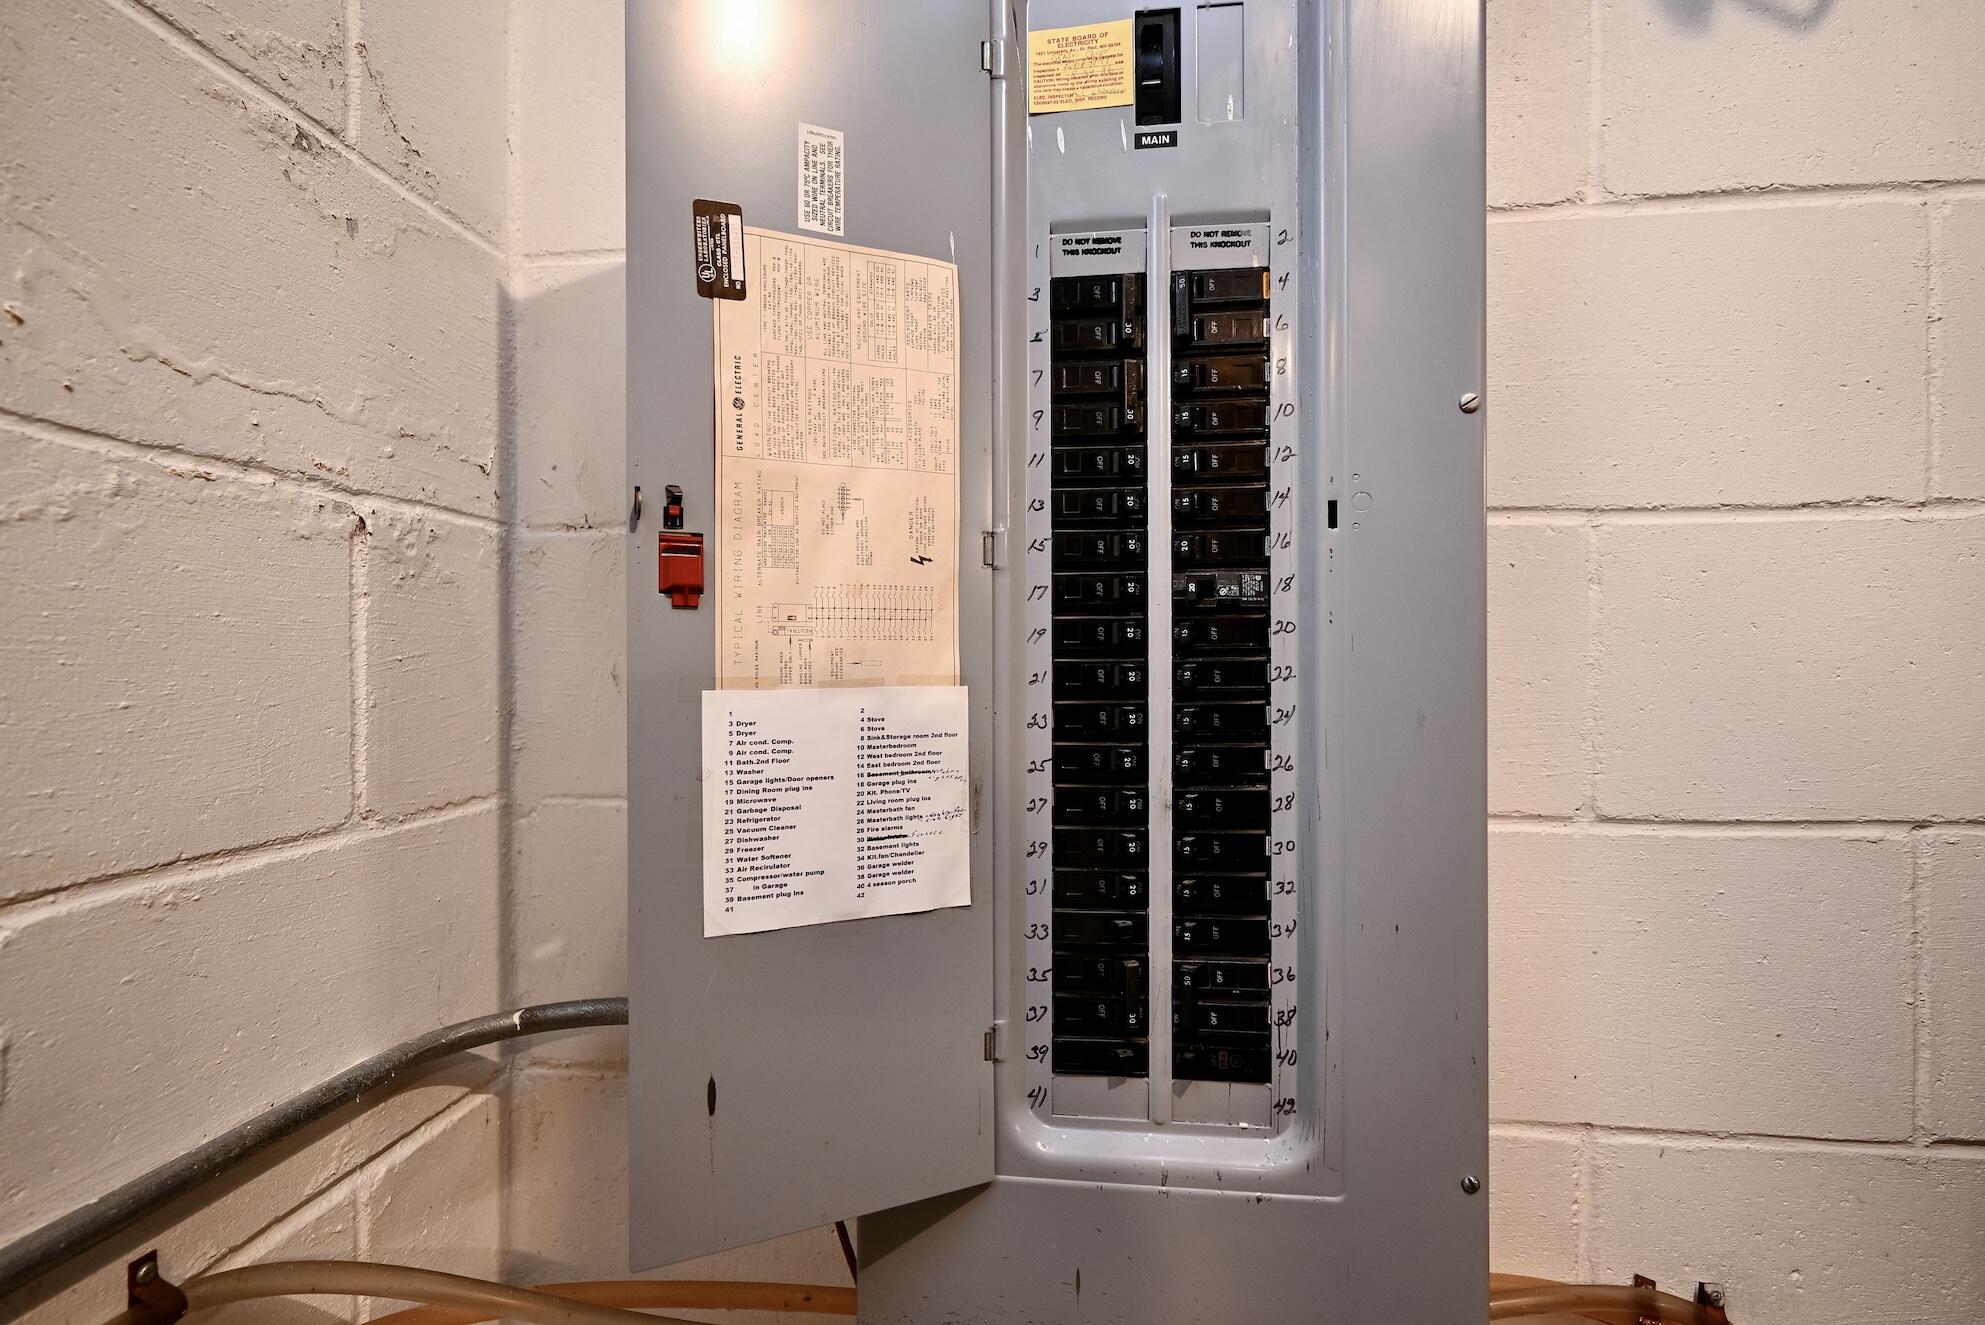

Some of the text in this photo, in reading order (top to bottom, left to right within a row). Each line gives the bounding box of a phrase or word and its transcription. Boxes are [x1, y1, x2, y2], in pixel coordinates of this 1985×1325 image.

[1057, 39, 1098, 48] ELECTRICITY
[1142, 135, 1169, 145] MAIN
[812, 176, 817, 184] ON
[804, 190, 810, 198] OR
[1210, 240, 1251, 248] KNOCKOUT
[1277, 230, 1293, 245] 2
[1278, 272, 1289, 291] 4
[1125, 322, 1131, 333] 30
[1275, 314, 1289, 331] 6
[1277, 359, 1287, 374] 8
[1033, 370, 1043, 386] 7
[1274, 403, 1294, 421] 10
[1127, 455, 1134, 465] 20
[1272, 445, 1297, 462] 12
[734, 482, 743, 665] TYPICAL WIRING DIAGRAM
[1189, 583, 1195, 592] 20
[1274, 574, 1295, 594] 18
[1028, 585, 1048, 602] 17
[1273, 621, 1295, 633] 20
[1028, 629, 1047, 643] 19
[1027, 713, 1047, 729] 23
[1272, 756, 1294, 771] 26
[1272, 841, 1295, 854] 30
[737, 893, 773, 901] Basement
[1272, 967, 1295, 984] 36
[1026, 1046, 1048, 1063] 39
[1027, 1089, 1047, 1109] 41
